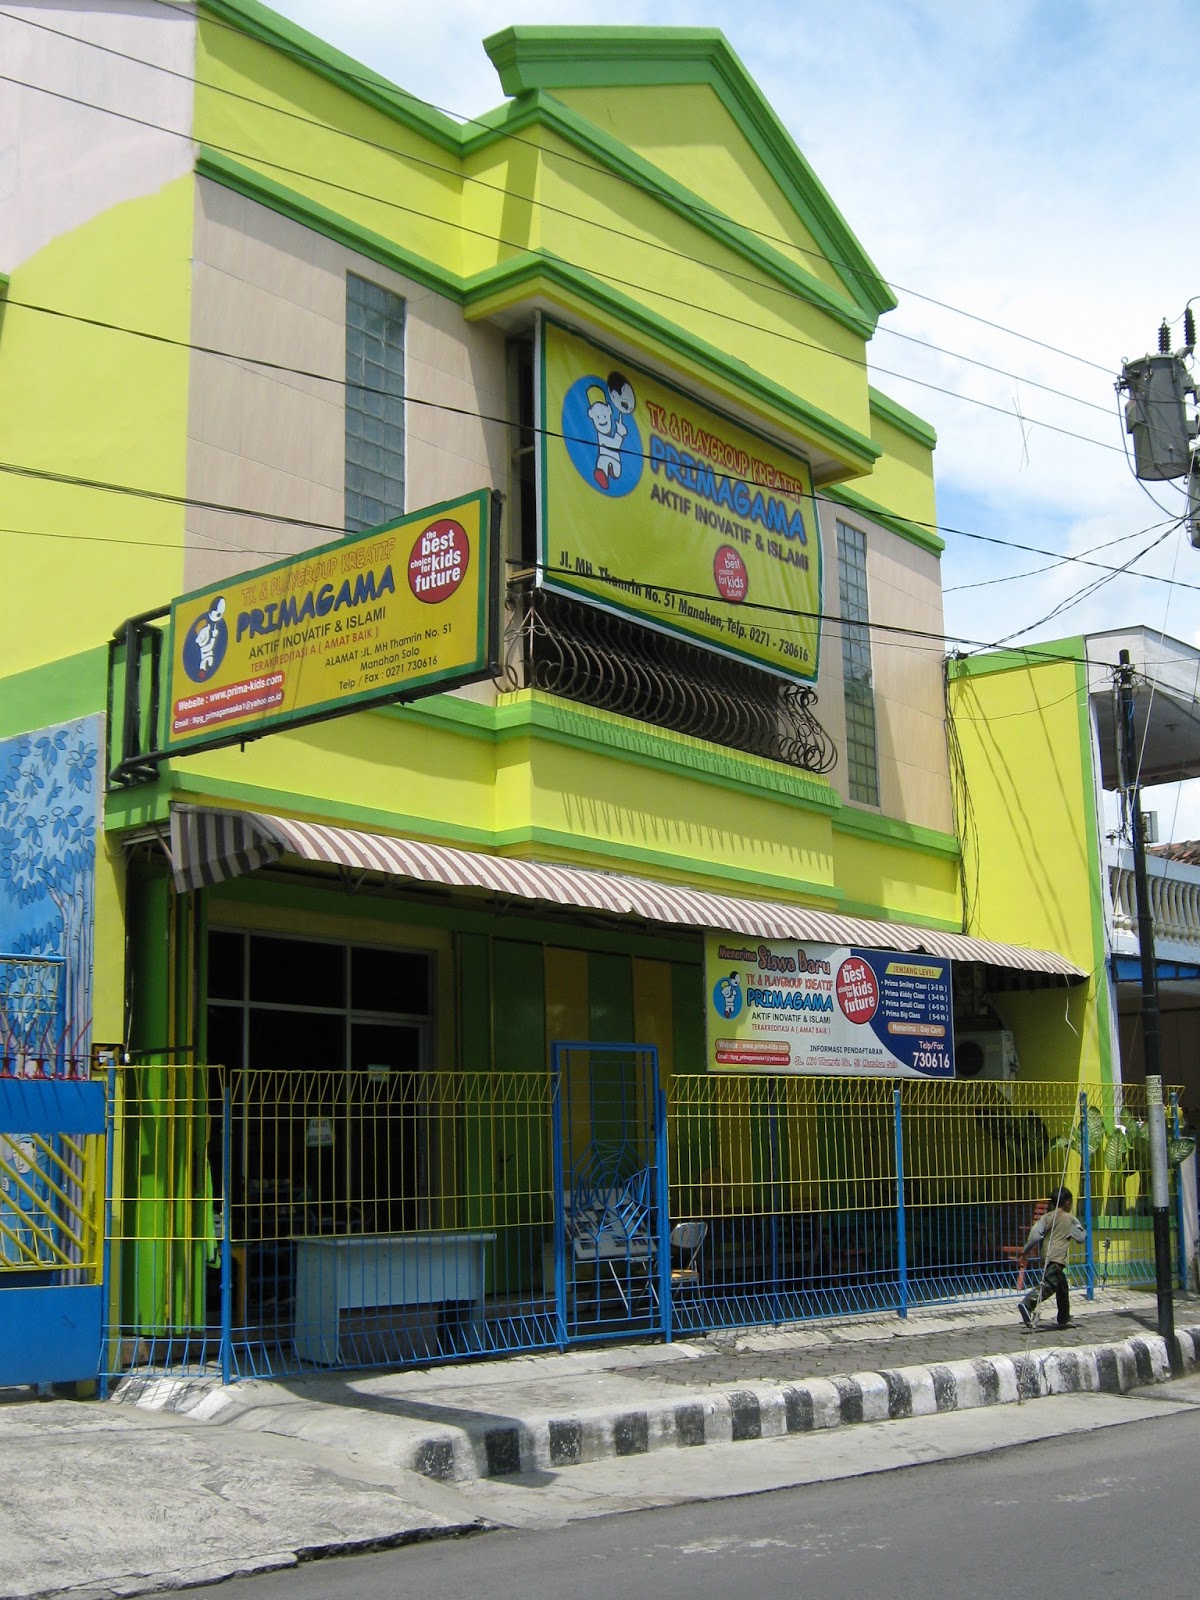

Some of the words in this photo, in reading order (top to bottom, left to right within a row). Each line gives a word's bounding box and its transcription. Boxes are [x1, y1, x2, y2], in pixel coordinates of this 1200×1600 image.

[646, 400, 668, 434] TK
[669, 413, 680, 442] &
[681, 419, 749, 477] PLAYGROUP
[751, 458, 803, 503] KREATIF
[650, 434, 807, 545] PRIMAGAMA
[426, 531, 436, 539] the
[651, 483, 691, 516] AKTIF
[695, 503, 751, 545] INOVATIF
[755, 534, 764, 552] &
[768, 539, 808, 571] ISLAMI
[422, 529, 454, 555] best
[410, 557, 431, 568] choice
[421, 564, 431, 573] for
[432, 549, 461, 571] kids
[725, 559, 740, 569] best
[241, 587, 256, 606] TK
[259, 582, 267, 600] &
[271, 557, 337, 597] PLAYGROUP
[341, 538, 396, 573] KREATIF
[415, 567, 460, 592] future
[718, 576, 727, 584] for
[727, 576, 744, 588] kids
[236, 565, 395, 643] PRIMAGAMA
[249, 639, 280, 659] AKTIF
[283, 623, 331, 649] INOVATIF
[335, 620, 342, 632] &
[346, 606, 386, 629] ISLAMI
[645, 586, 661, 605] No.
[664, 592, 675, 609] 51
[679, 598, 724, 631] Manahan,
[727, 617, 747, 640] Telp.
[750, 627, 770, 647] 0271
[779, 639, 809, 662] 730616
[251, 648, 307, 672] TERAKREDITASI
[310, 647, 316, 655] A
[324, 635, 349, 650] AMAT
[352, 629, 372, 642] BAIK
[325, 650, 358, 667] ALAMAT
[375, 643, 387, 653] MH
[390, 632, 422, 648] Thamrin
[425, 628, 439, 639] No.
[443, 623, 452, 633] 51
[360, 653, 399, 671] Manahan
[402, 647, 419, 659] Solo
[339, 679, 355, 690] Telp
[364, 673, 378, 683] Fax
[386, 664, 404, 677] 0271
[408, 656, 437, 671] 730616
[178, 697, 204, 711] Website
[209, 674, 282, 702] www.prima-kids.com
[175, 718, 189, 728] Email
[718, 945, 757, 962] Menerima
[758, 945, 796, 973] Siswa
[842, 965, 866, 983] best
[893, 966, 917, 975] JENJANG
[919, 968, 935, 976] LEVEL
[746, 974, 755, 985] TK
[765, 975, 802, 989] PLAYGROUP
[805, 978, 833, 991] KREATIF
[852, 981, 873, 997] kids
[747, 988, 834, 1012] PRIMAGAMA
[900, 991, 912, 999] Kiddy
[845, 996, 875, 1013] future
[752, 1012, 771, 1020] AKTIF
[773, 1014, 801, 1022] INOVATIF
[810, 1016, 830, 1024] ISLAMI
[900, 1011, 908, 1019] Big
[752, 1024, 789, 1032] TERAKREDITASI
[893, 1024, 916, 1032] Menerima
[920, 1025, 929, 1034] Day
[810, 1045, 842, 1053] INFORMASI
[844, 1047, 883, 1055] PENDAFTARAN
[919, 1041, 944, 1051] Telp/Fax
[913, 1052, 950, 1068] 730616
